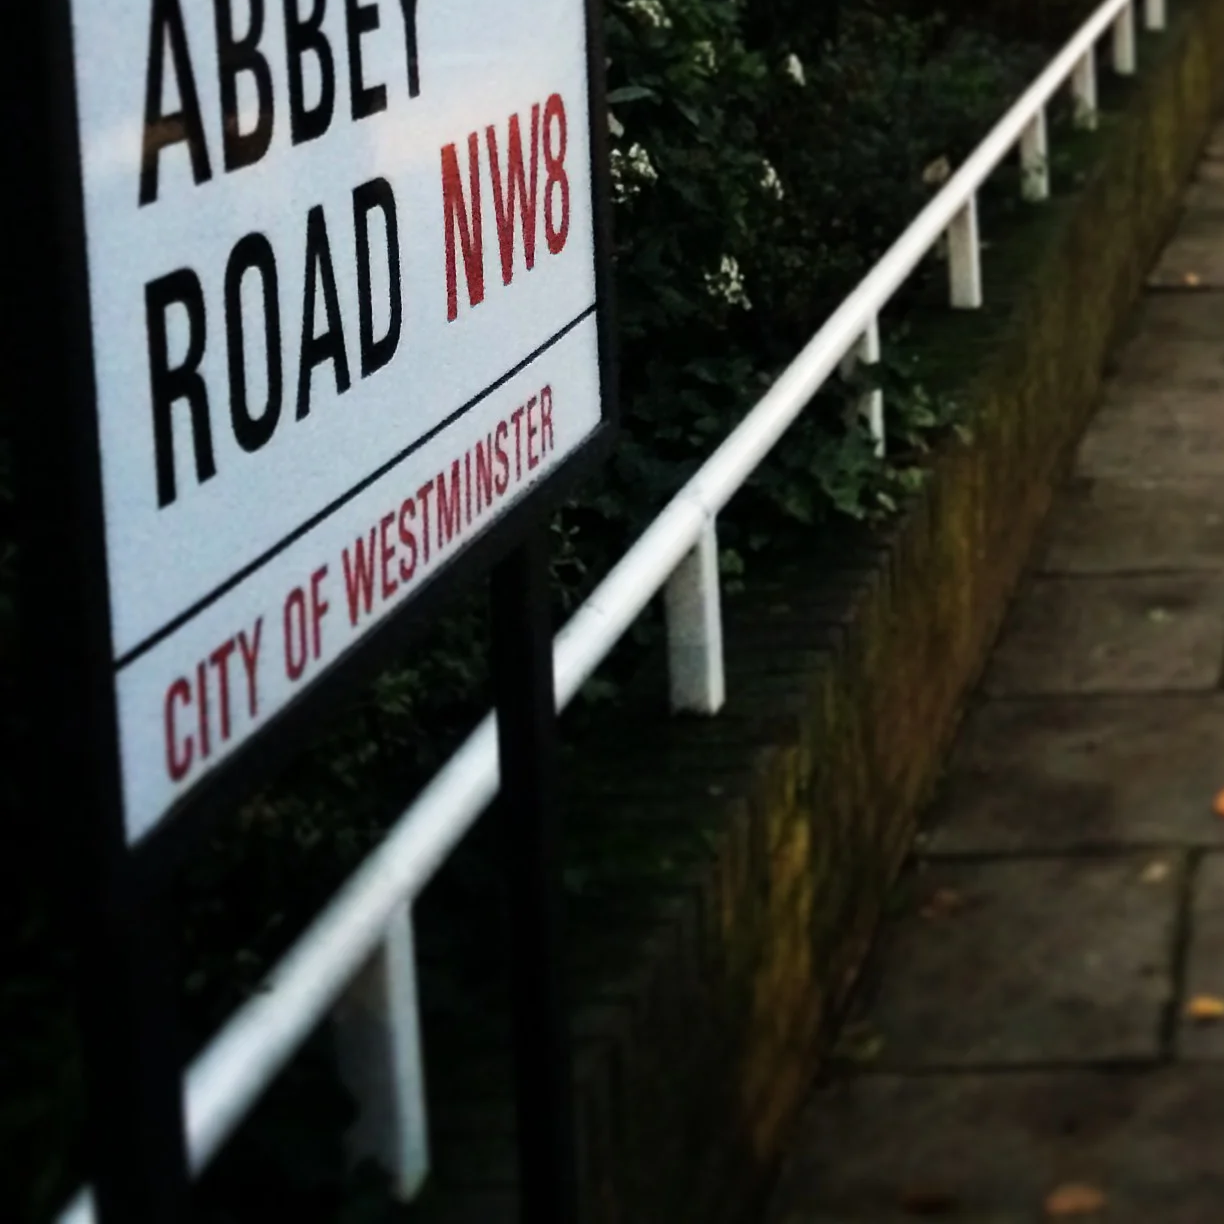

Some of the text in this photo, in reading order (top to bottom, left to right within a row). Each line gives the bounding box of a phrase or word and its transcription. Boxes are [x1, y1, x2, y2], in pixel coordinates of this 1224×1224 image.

[144, 93, 570, 508] ROAD NW8
[164, 384, 555, 782] CITY OF WESTMINSTER
